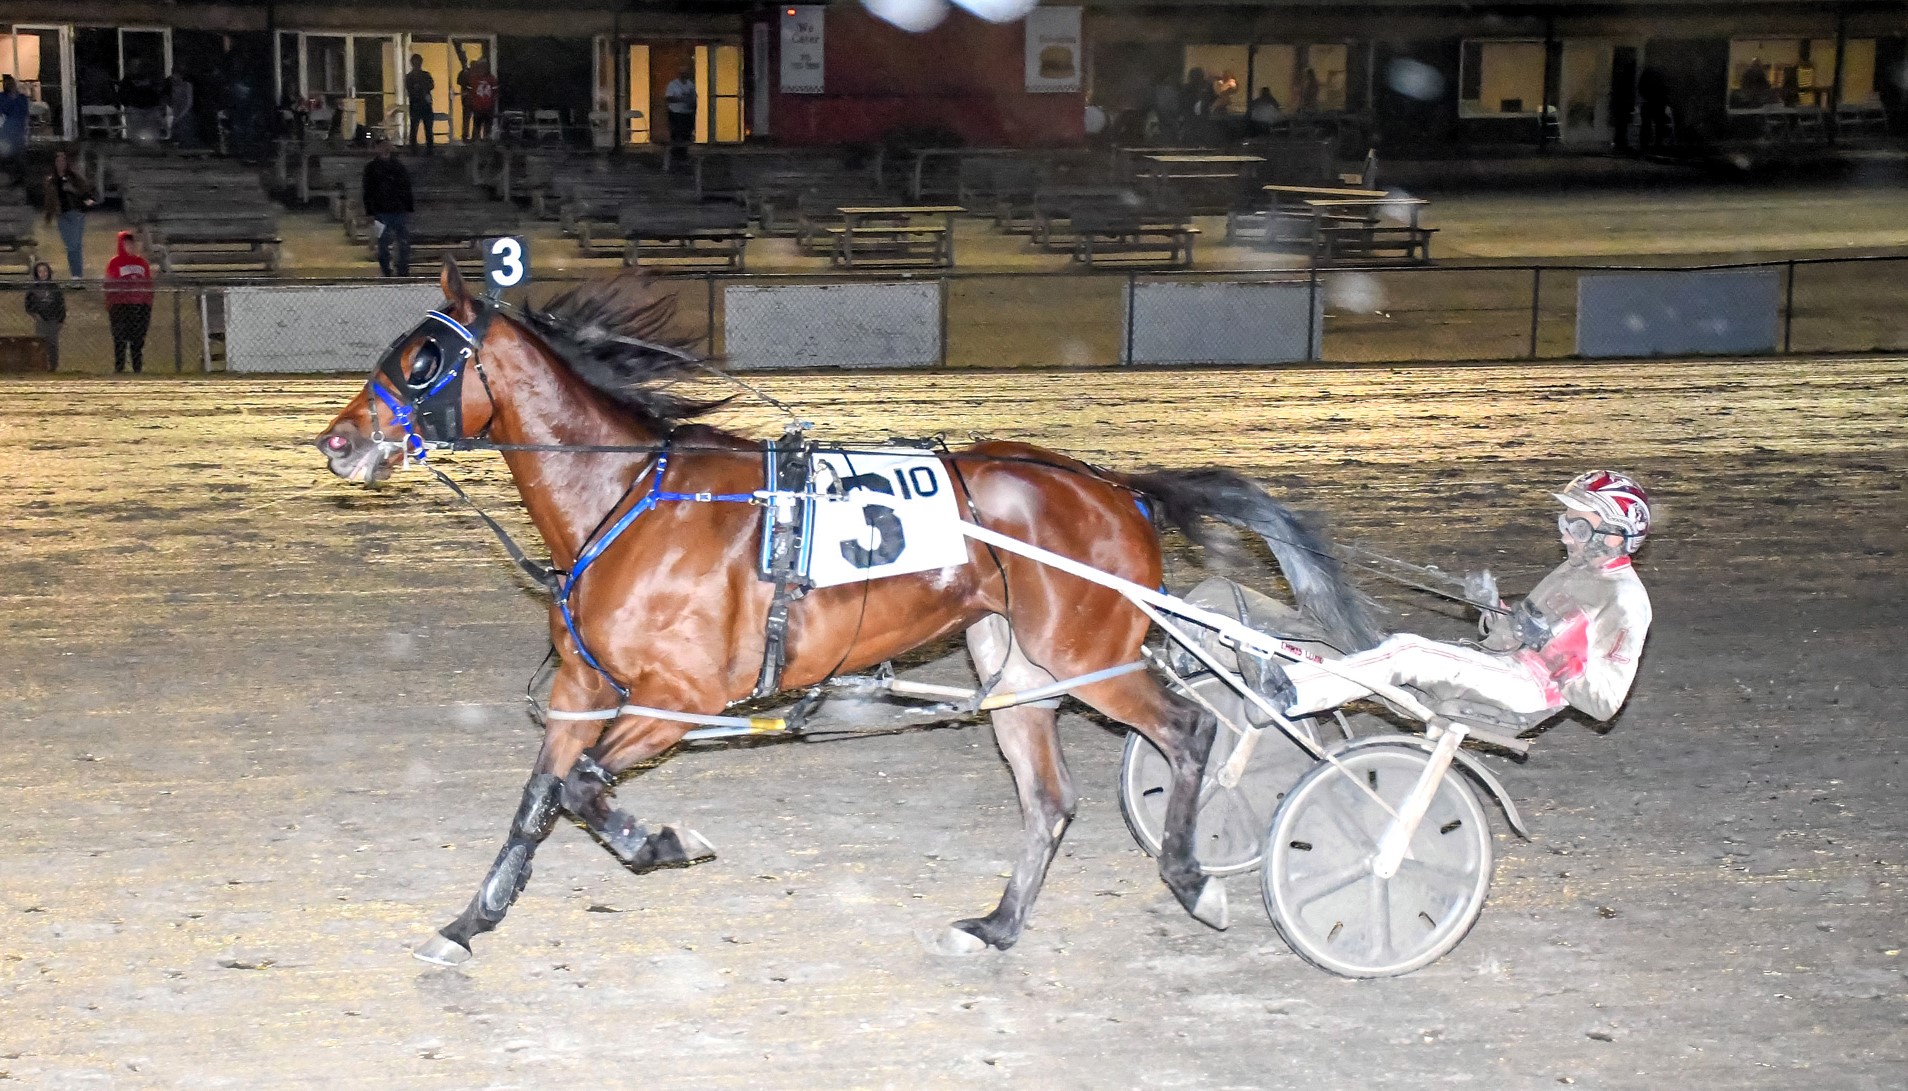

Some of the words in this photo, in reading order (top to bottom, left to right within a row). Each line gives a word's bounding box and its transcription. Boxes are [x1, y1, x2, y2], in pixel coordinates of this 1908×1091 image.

[491, 237, 524, 286] 3
[893, 466, 939, 500] 10
[826, 472, 906, 569] 3
